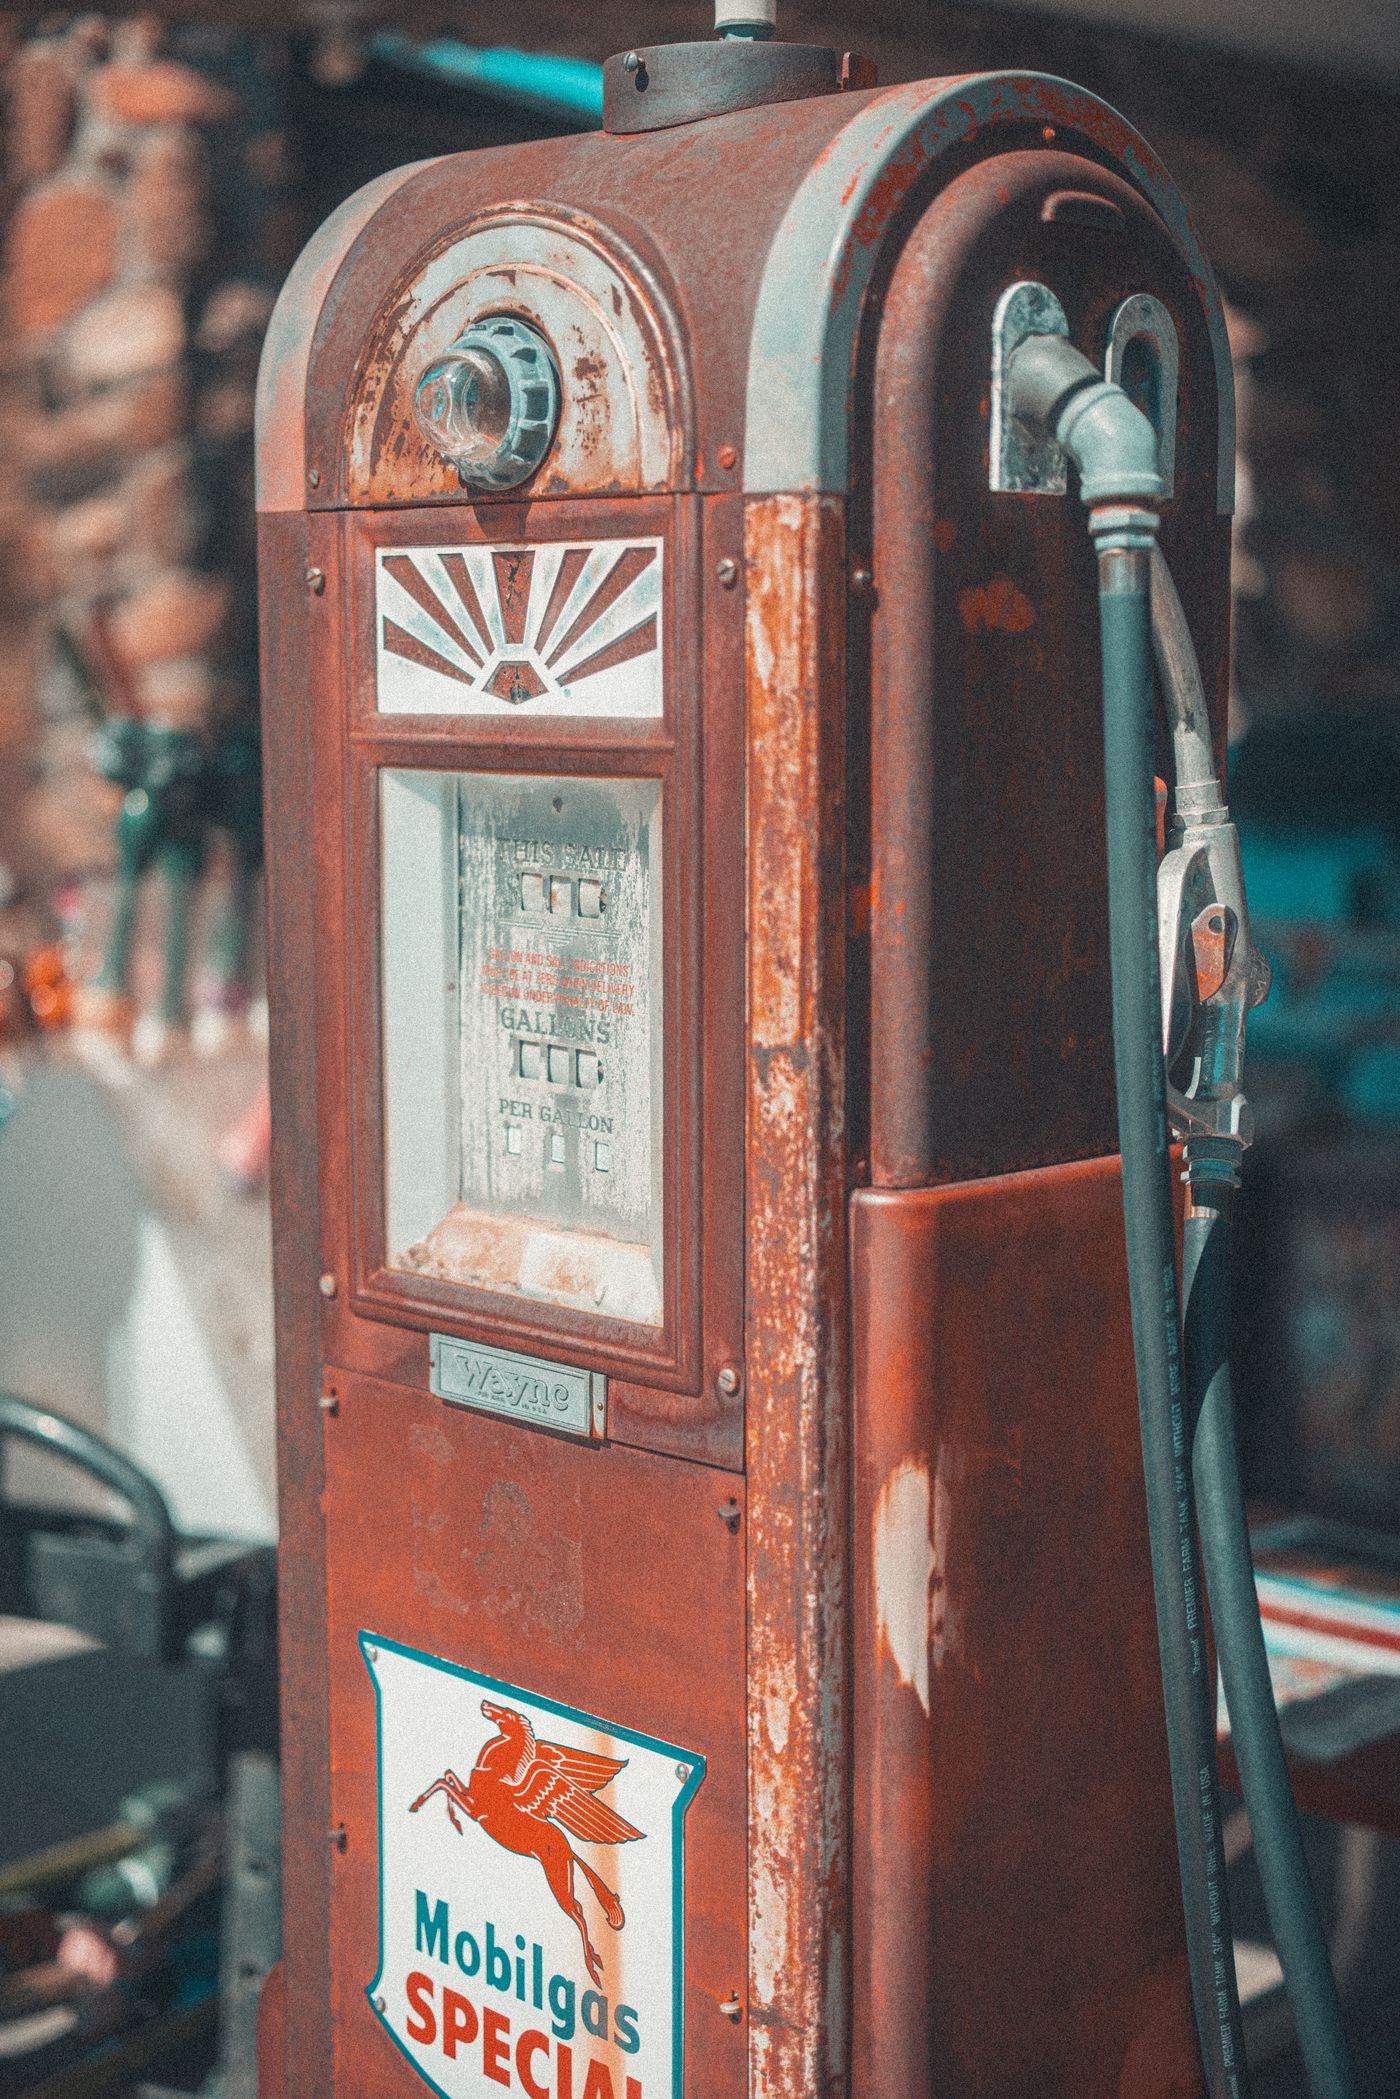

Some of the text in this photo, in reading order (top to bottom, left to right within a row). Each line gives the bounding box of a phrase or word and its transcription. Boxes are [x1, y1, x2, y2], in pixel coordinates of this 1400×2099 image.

[497, 837, 554, 864] THIS
[555, 992, 596, 1010] PENALTY
[591, 978, 635, 998] DELIVERY
[501, 1008, 611, 1044] GALLONS
[499, 1098, 614, 1134] PER GALLON
[456, 1354, 569, 1411] Wayne
[1178, 1497, 1190, 1534] TANK
[1181, 1536, 1193, 1573] FARM
[1184, 1576, 1198, 1630] PREMIER
[1199, 1764, 1211, 1789] USA
[1202, 1810, 1215, 1843] MADE
[1207, 1879, 1221, 1926] WITHOUT
[415, 1888, 641, 2055] Mobilgas
[1214, 1957, 1227, 1986] TANK
[1217, 1988, 1230, 2019] FARM
[1220, 2022, 1235, 2068] PREMIER
